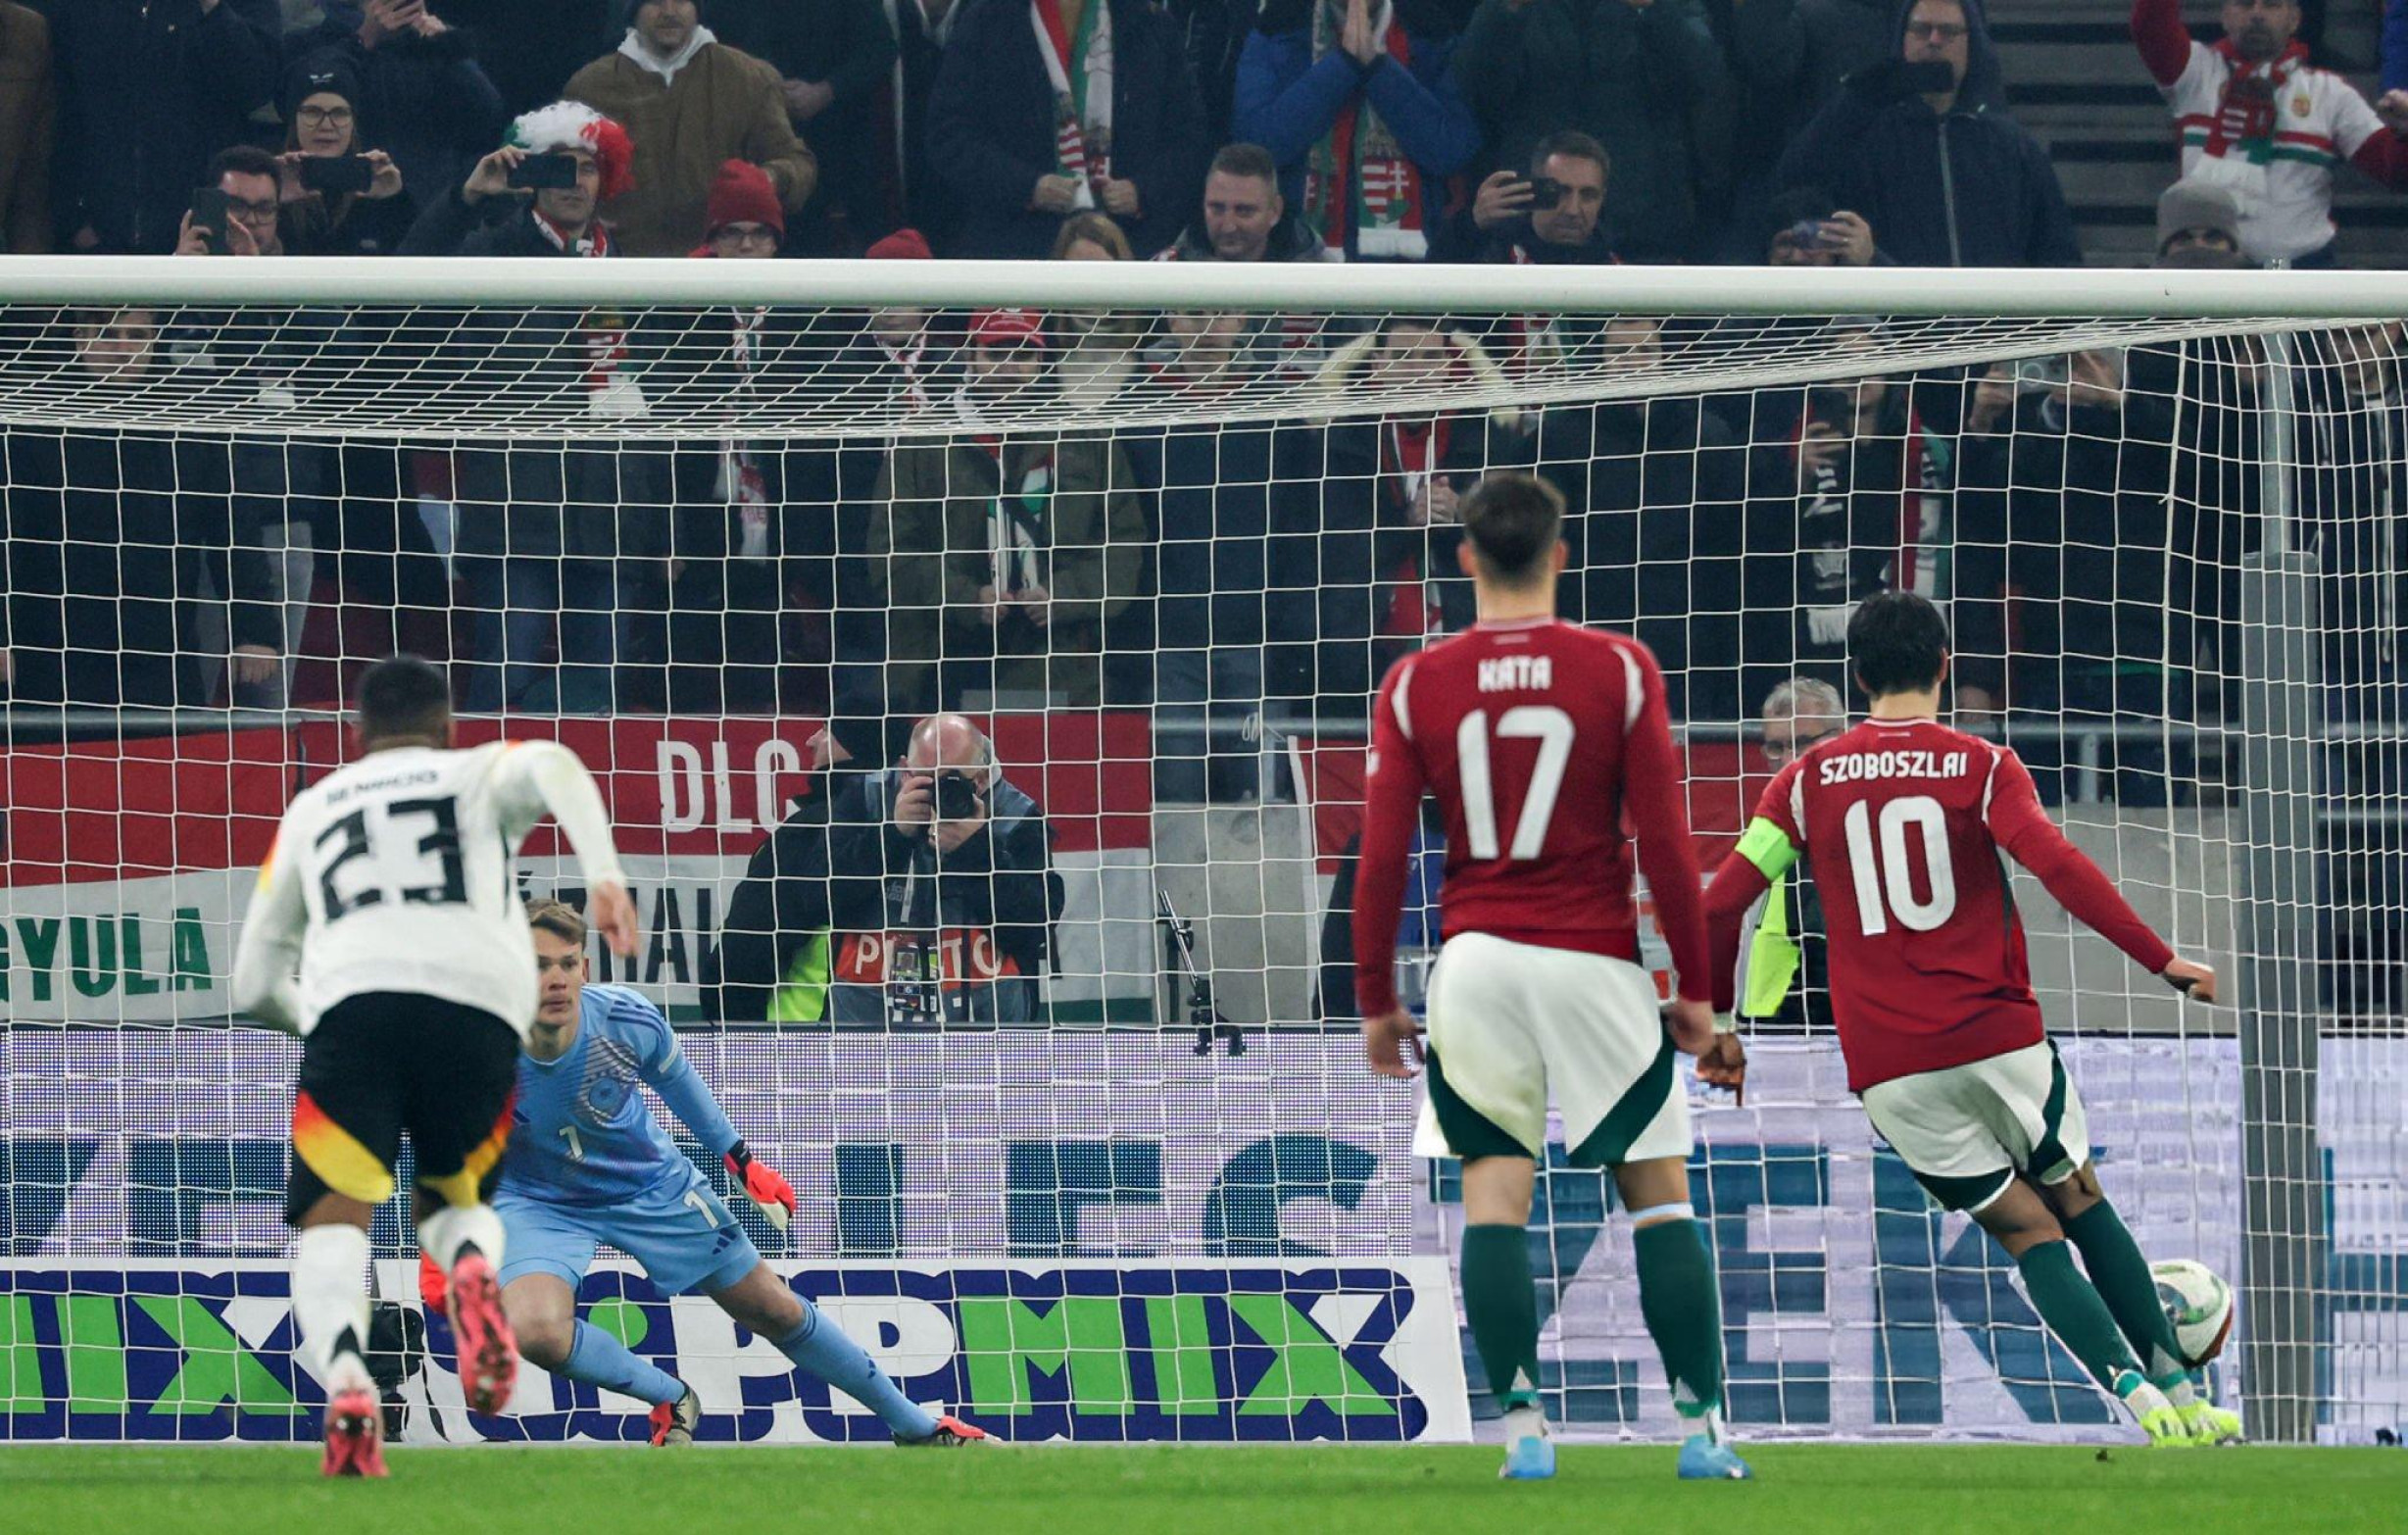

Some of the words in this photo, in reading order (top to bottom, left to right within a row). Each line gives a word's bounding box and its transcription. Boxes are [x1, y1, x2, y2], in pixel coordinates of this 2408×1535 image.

[1478, 655, 1552, 692] KATA
[1456, 704, 1576, 860] 17
[1820, 751, 1968, 785] SZOBOSZLAI
[314, 796, 467, 922] 23
[1844, 795, 1956, 936] 10
[0, 908, 212, 1002] YULA
[855, 932, 1004, 981] PTO
[559, 1126, 583, 1160] 1
[684, 1189, 719, 1229] 1
[0, 1295, 310, 1414] IX
[470, 1292, 1399, 1415] iPPMIX
